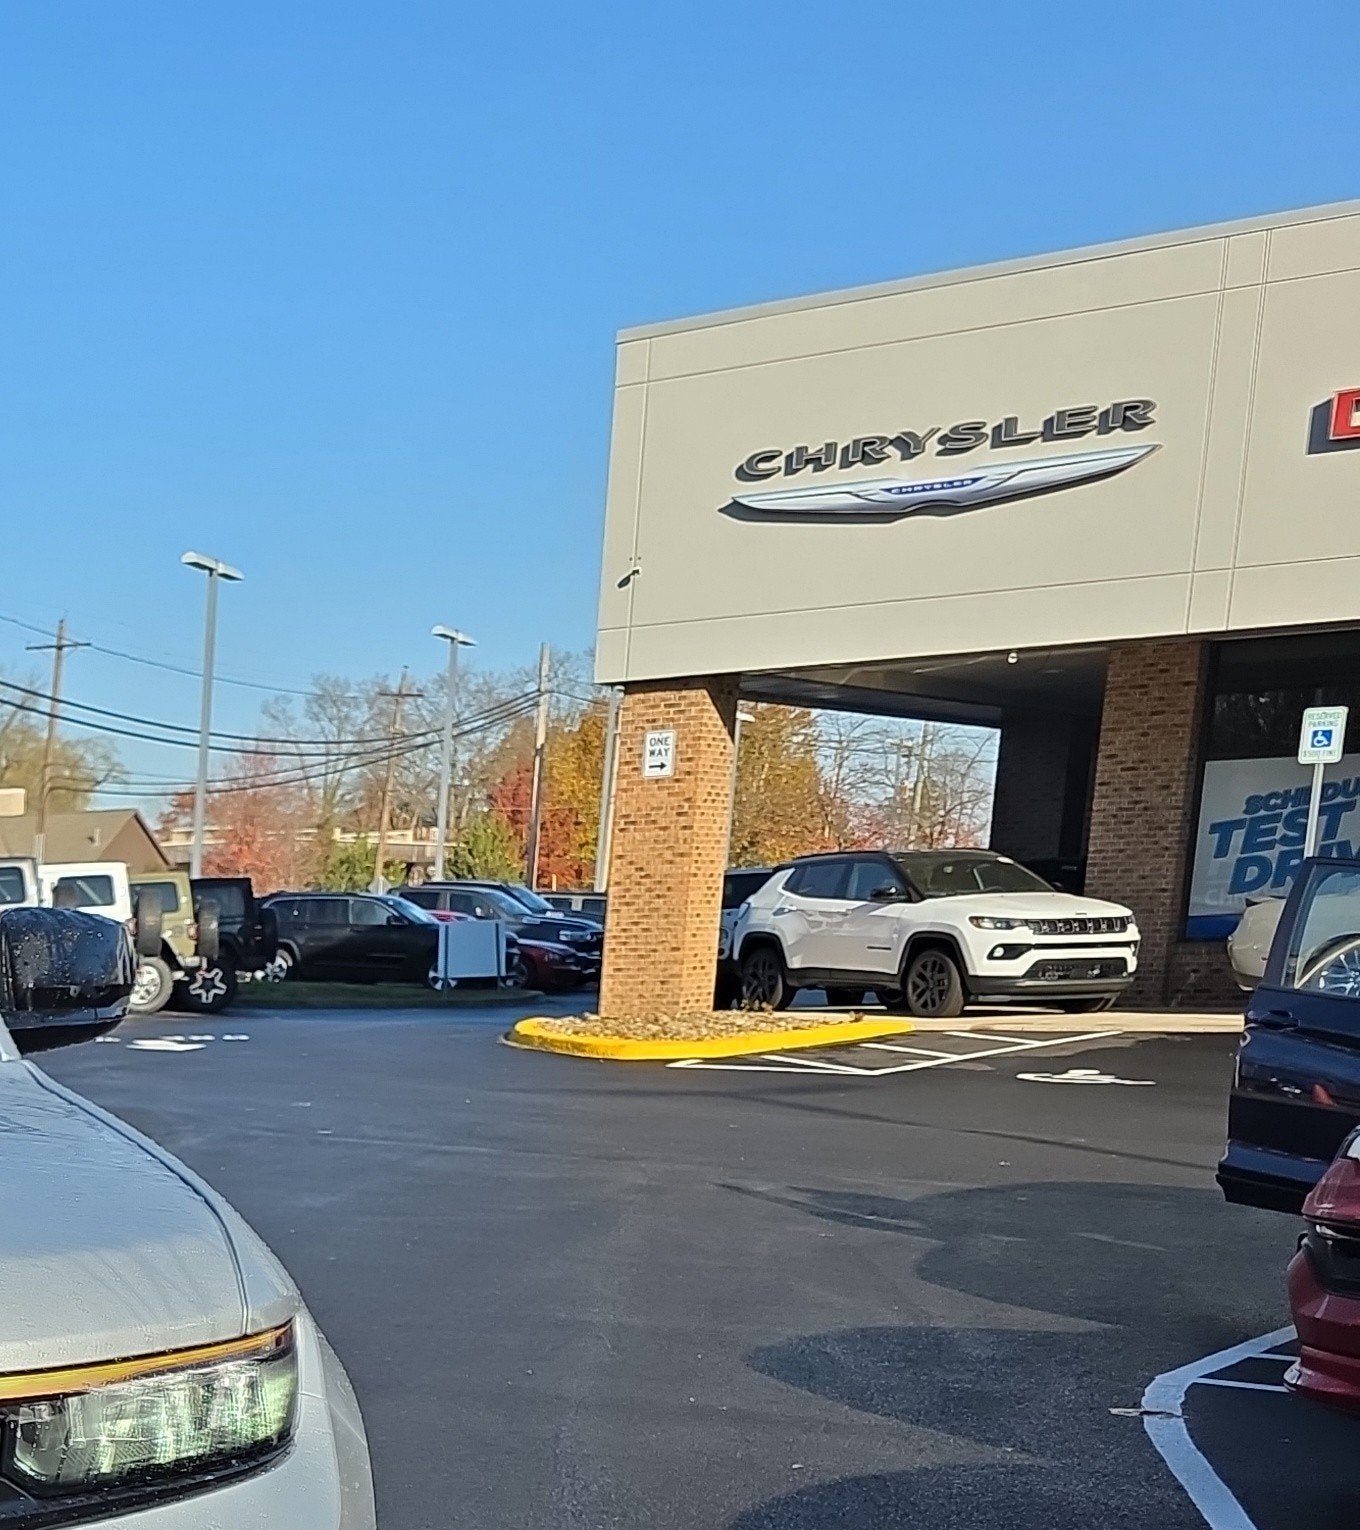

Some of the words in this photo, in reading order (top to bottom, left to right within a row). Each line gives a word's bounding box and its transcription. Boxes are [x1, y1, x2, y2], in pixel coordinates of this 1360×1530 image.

[737, 398, 1158, 480] CHRYSLER
[891, 479, 973, 494] CHRYSLER
[1307, 720, 1339, 728] PARKING
[649, 736, 670, 747] ONE
[648, 747, 671, 757] WAY
[1208, 799, 1357, 859] TEST
